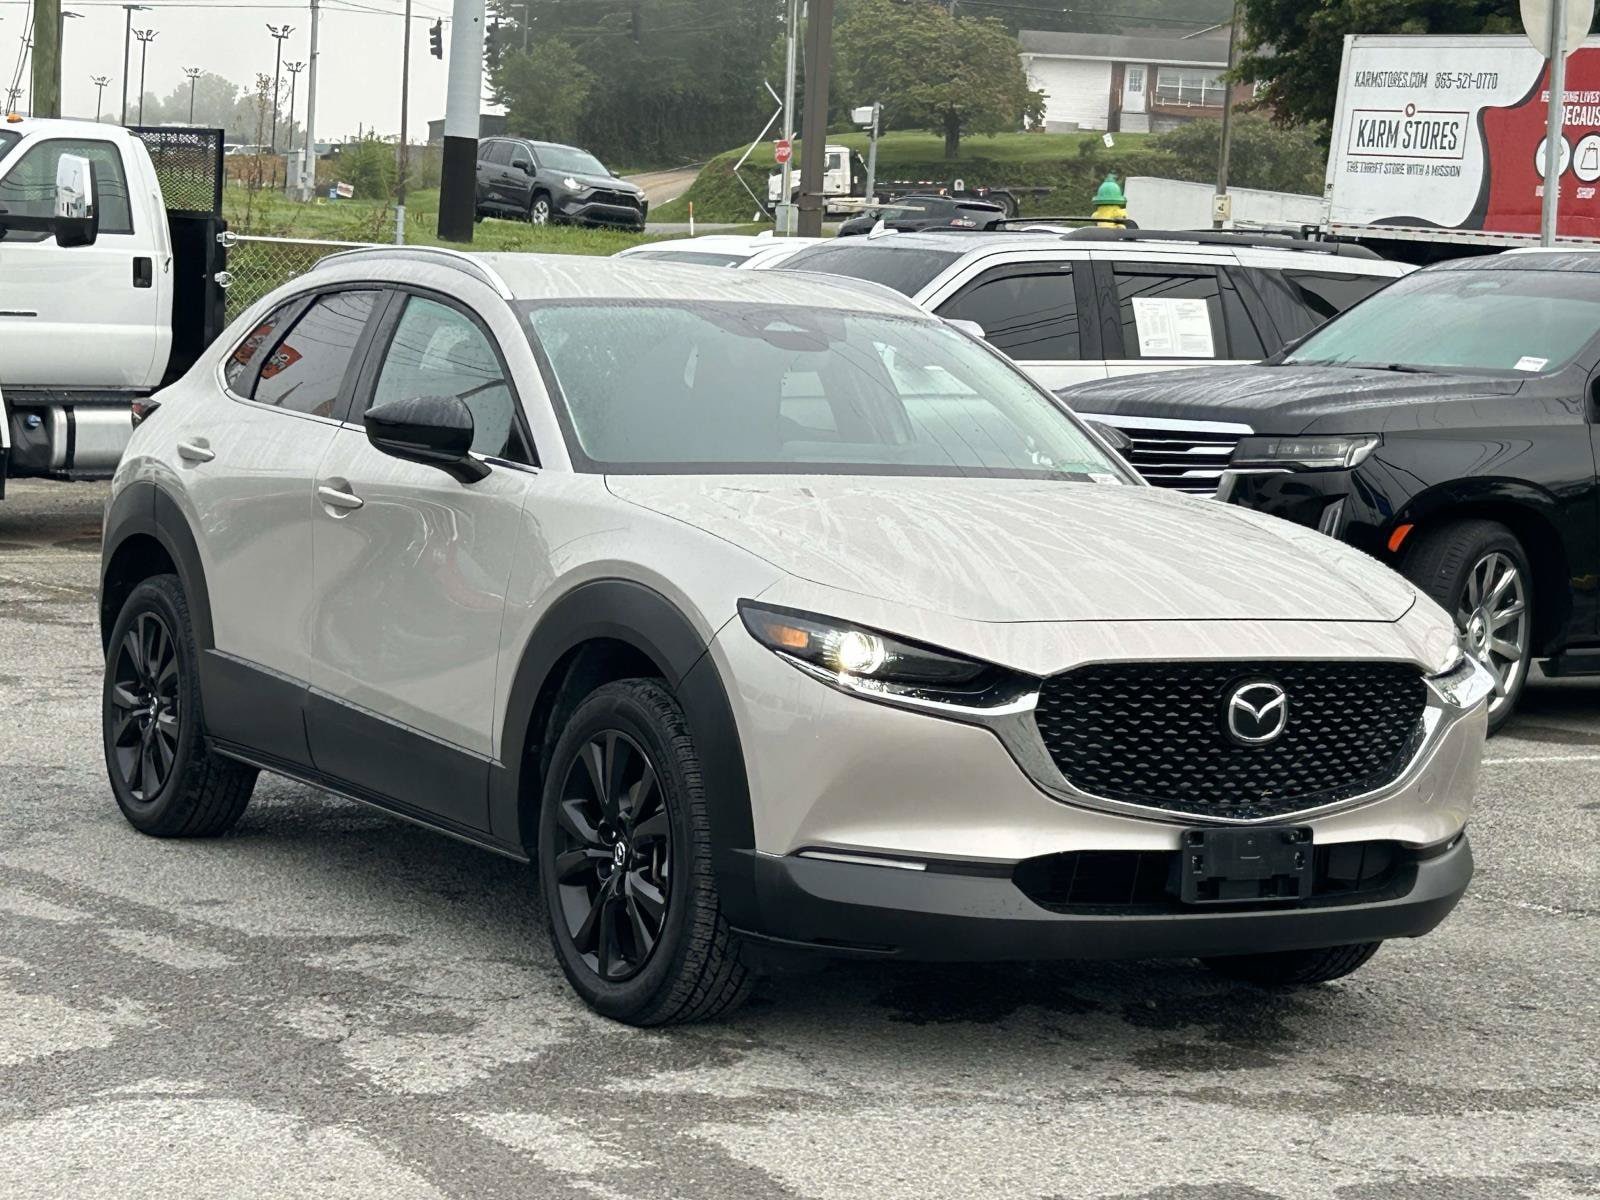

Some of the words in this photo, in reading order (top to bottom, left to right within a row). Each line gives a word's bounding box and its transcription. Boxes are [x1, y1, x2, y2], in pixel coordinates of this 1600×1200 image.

[1354, 71, 1428, 88] KARMSTORES.COM
[1434, 72, 1498, 89] 865-521-0770
[1579, 91, 1600, 103] LIVES
[1356, 119, 1400, 148] KARM
[1402, 121, 1459, 150] STORES
[776, 146, 790, 156] STOP
